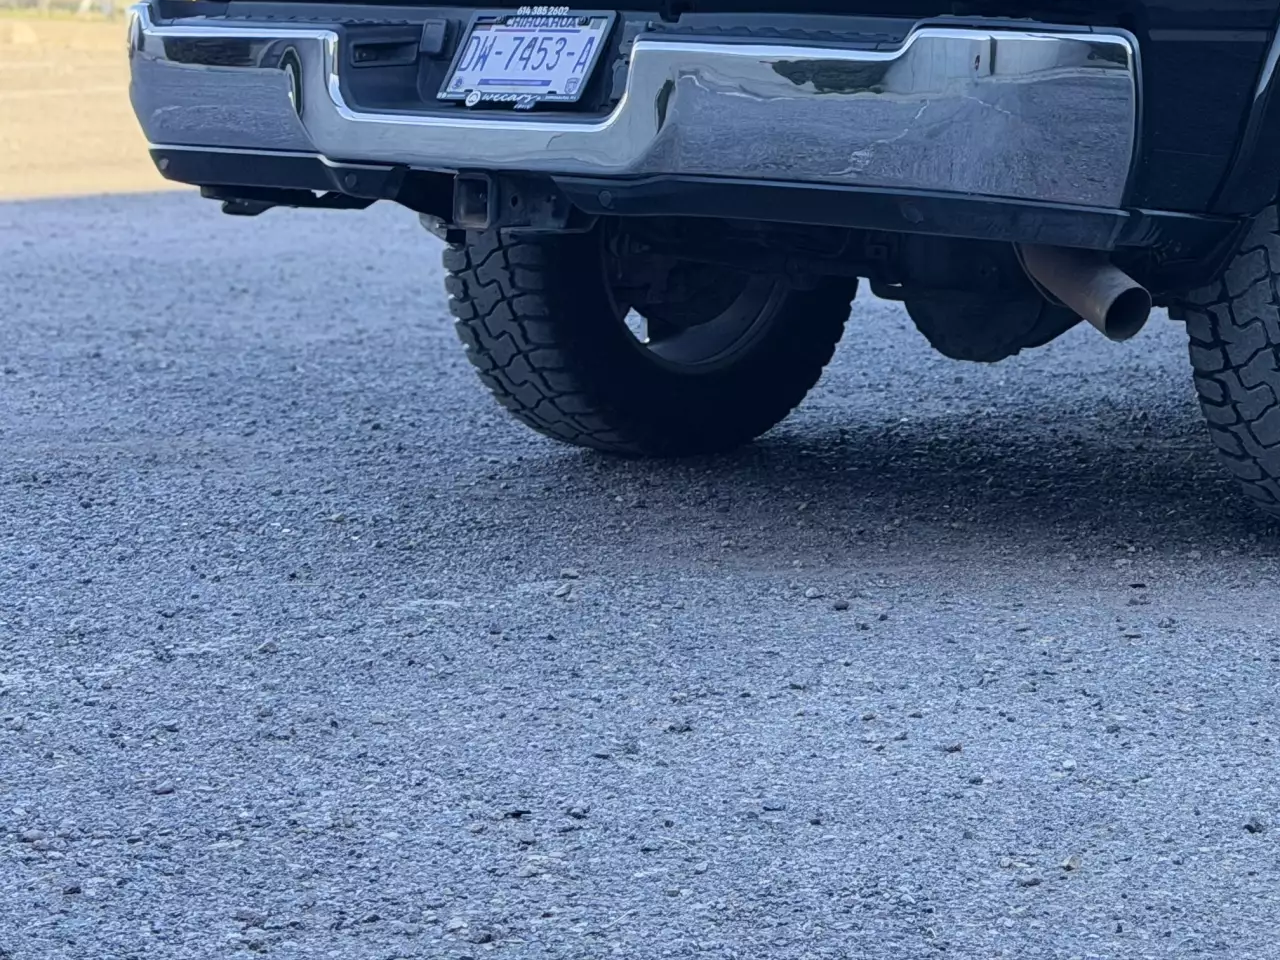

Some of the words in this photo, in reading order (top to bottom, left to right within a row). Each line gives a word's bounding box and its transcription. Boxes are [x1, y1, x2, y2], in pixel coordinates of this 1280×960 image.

[517, 6, 531, 15] 614
[532, 6, 548, 15] 385
[548, 6, 569, 15] 2602
[505, 17, 577, 28] CHIHUAHUA
